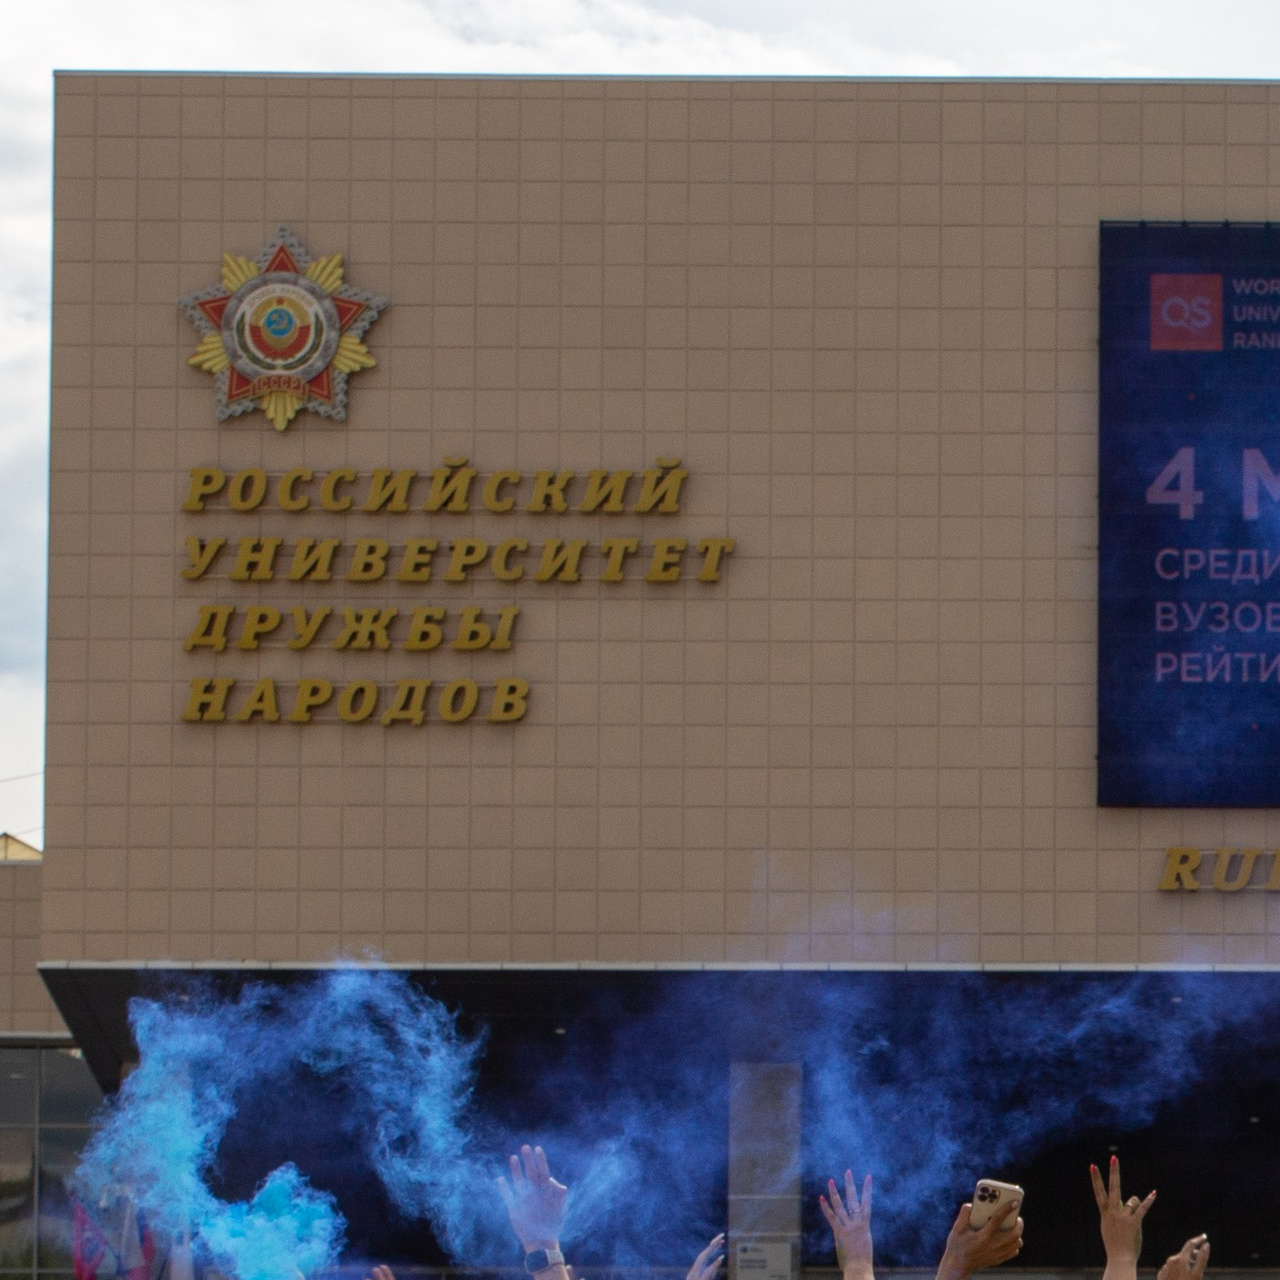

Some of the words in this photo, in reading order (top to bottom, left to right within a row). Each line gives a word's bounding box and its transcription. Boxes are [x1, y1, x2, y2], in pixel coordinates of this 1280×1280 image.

[1161, 296, 1212, 330] QS
[181, 456, 688, 513] РОССИЙСКИЙ
[1146, 447, 1203, 520] 4
[180, 537, 734, 583] УНИВЕРСИТЕТ
[183, 604, 519, 652] ДРУЖБЫ
[181, 677, 531, 727] НАРОДОВ
